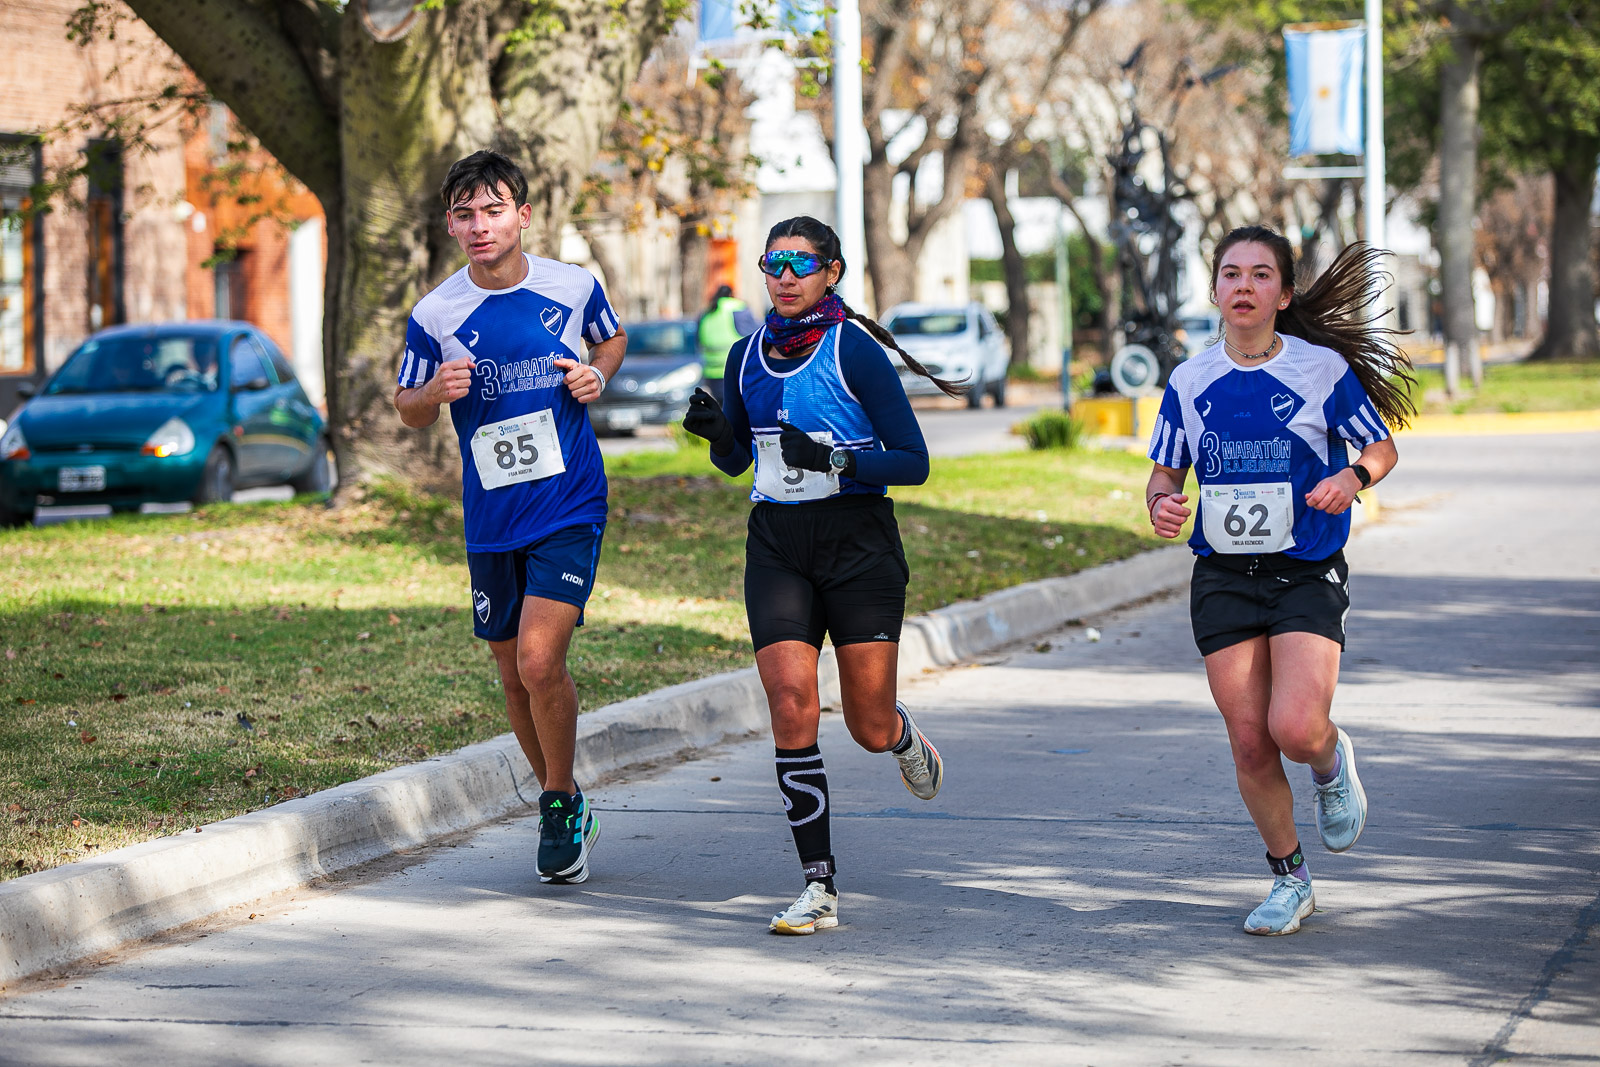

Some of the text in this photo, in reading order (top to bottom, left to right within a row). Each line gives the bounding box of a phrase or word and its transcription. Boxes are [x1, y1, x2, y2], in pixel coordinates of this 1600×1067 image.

[475, 359, 500, 400] 3
[493, 433, 539, 469] 85
[1203, 431, 1291, 477] 3 MARATÓN
[1224, 503, 1271, 537] 62
